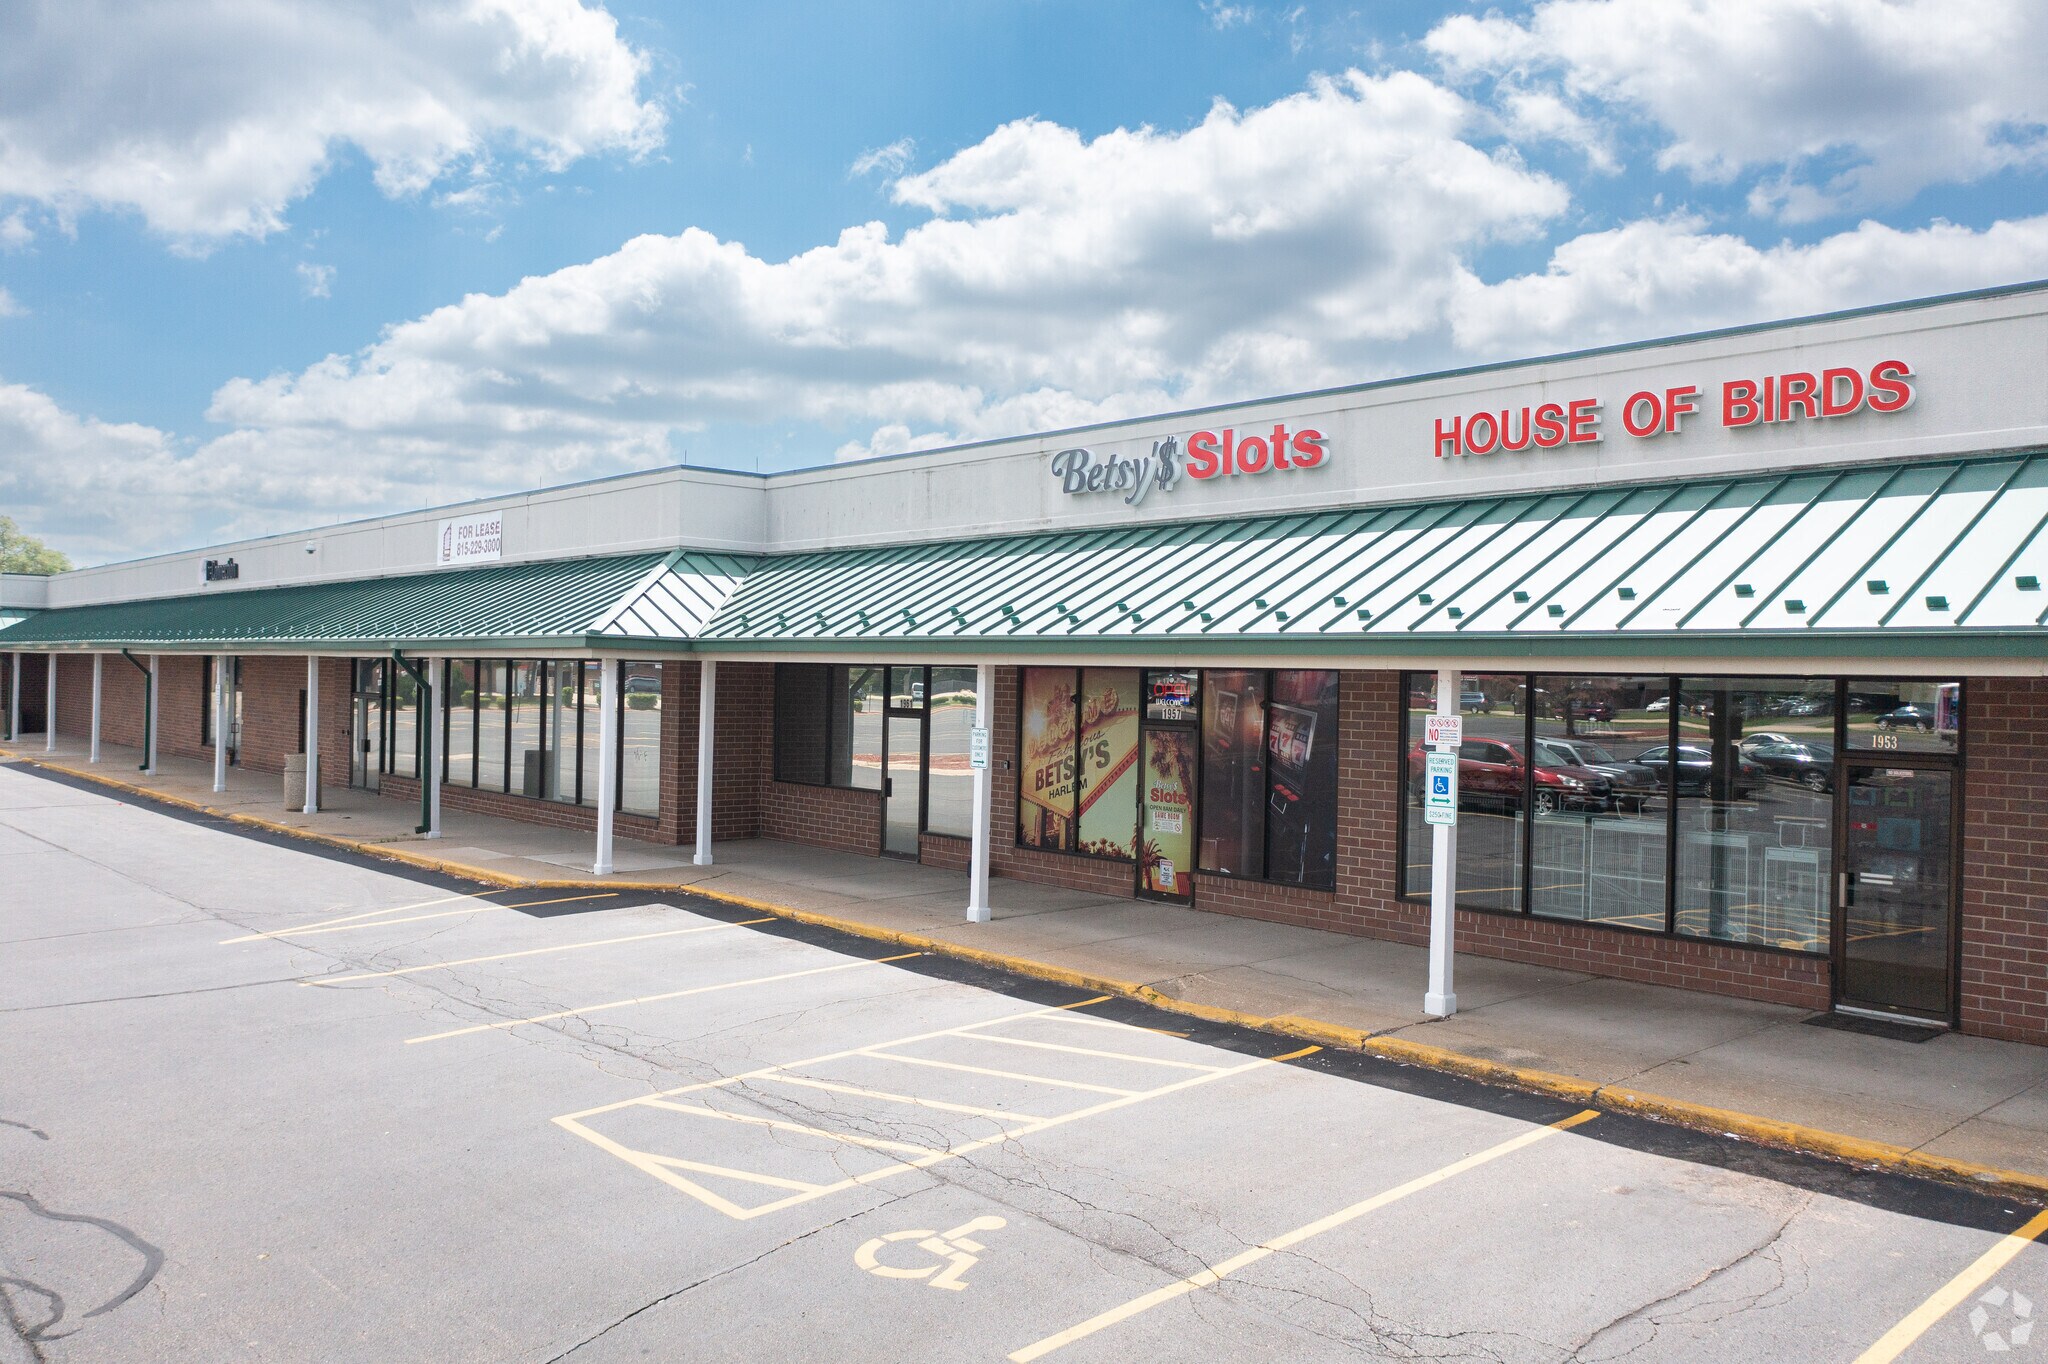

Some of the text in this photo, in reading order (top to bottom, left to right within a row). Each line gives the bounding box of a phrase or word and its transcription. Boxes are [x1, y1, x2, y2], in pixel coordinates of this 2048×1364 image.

[1434, 360, 1917, 458] HOUSE OF BIRDS
[1186, 423, 1330, 480] Slots
[458, 521, 500, 539] FOR LEASE
[456, 538, 500, 556] 815-229-3000
[1153, 682, 1191, 698] OPEN
[1155, 698, 1184, 707] WELCOME
[1162, 708, 1182, 720] 1957
[1428, 728, 1440, 741] NO
[1872, 735, 1898, 749] 1953
[1035, 739, 1111, 791] BETSY'S
[1429, 757, 1454, 766] RESERVED
[1430, 765, 1453, 774] PARKING
[1048, 778, 1088, 800] HARLEM
[1150, 787, 1187, 805] Slots
